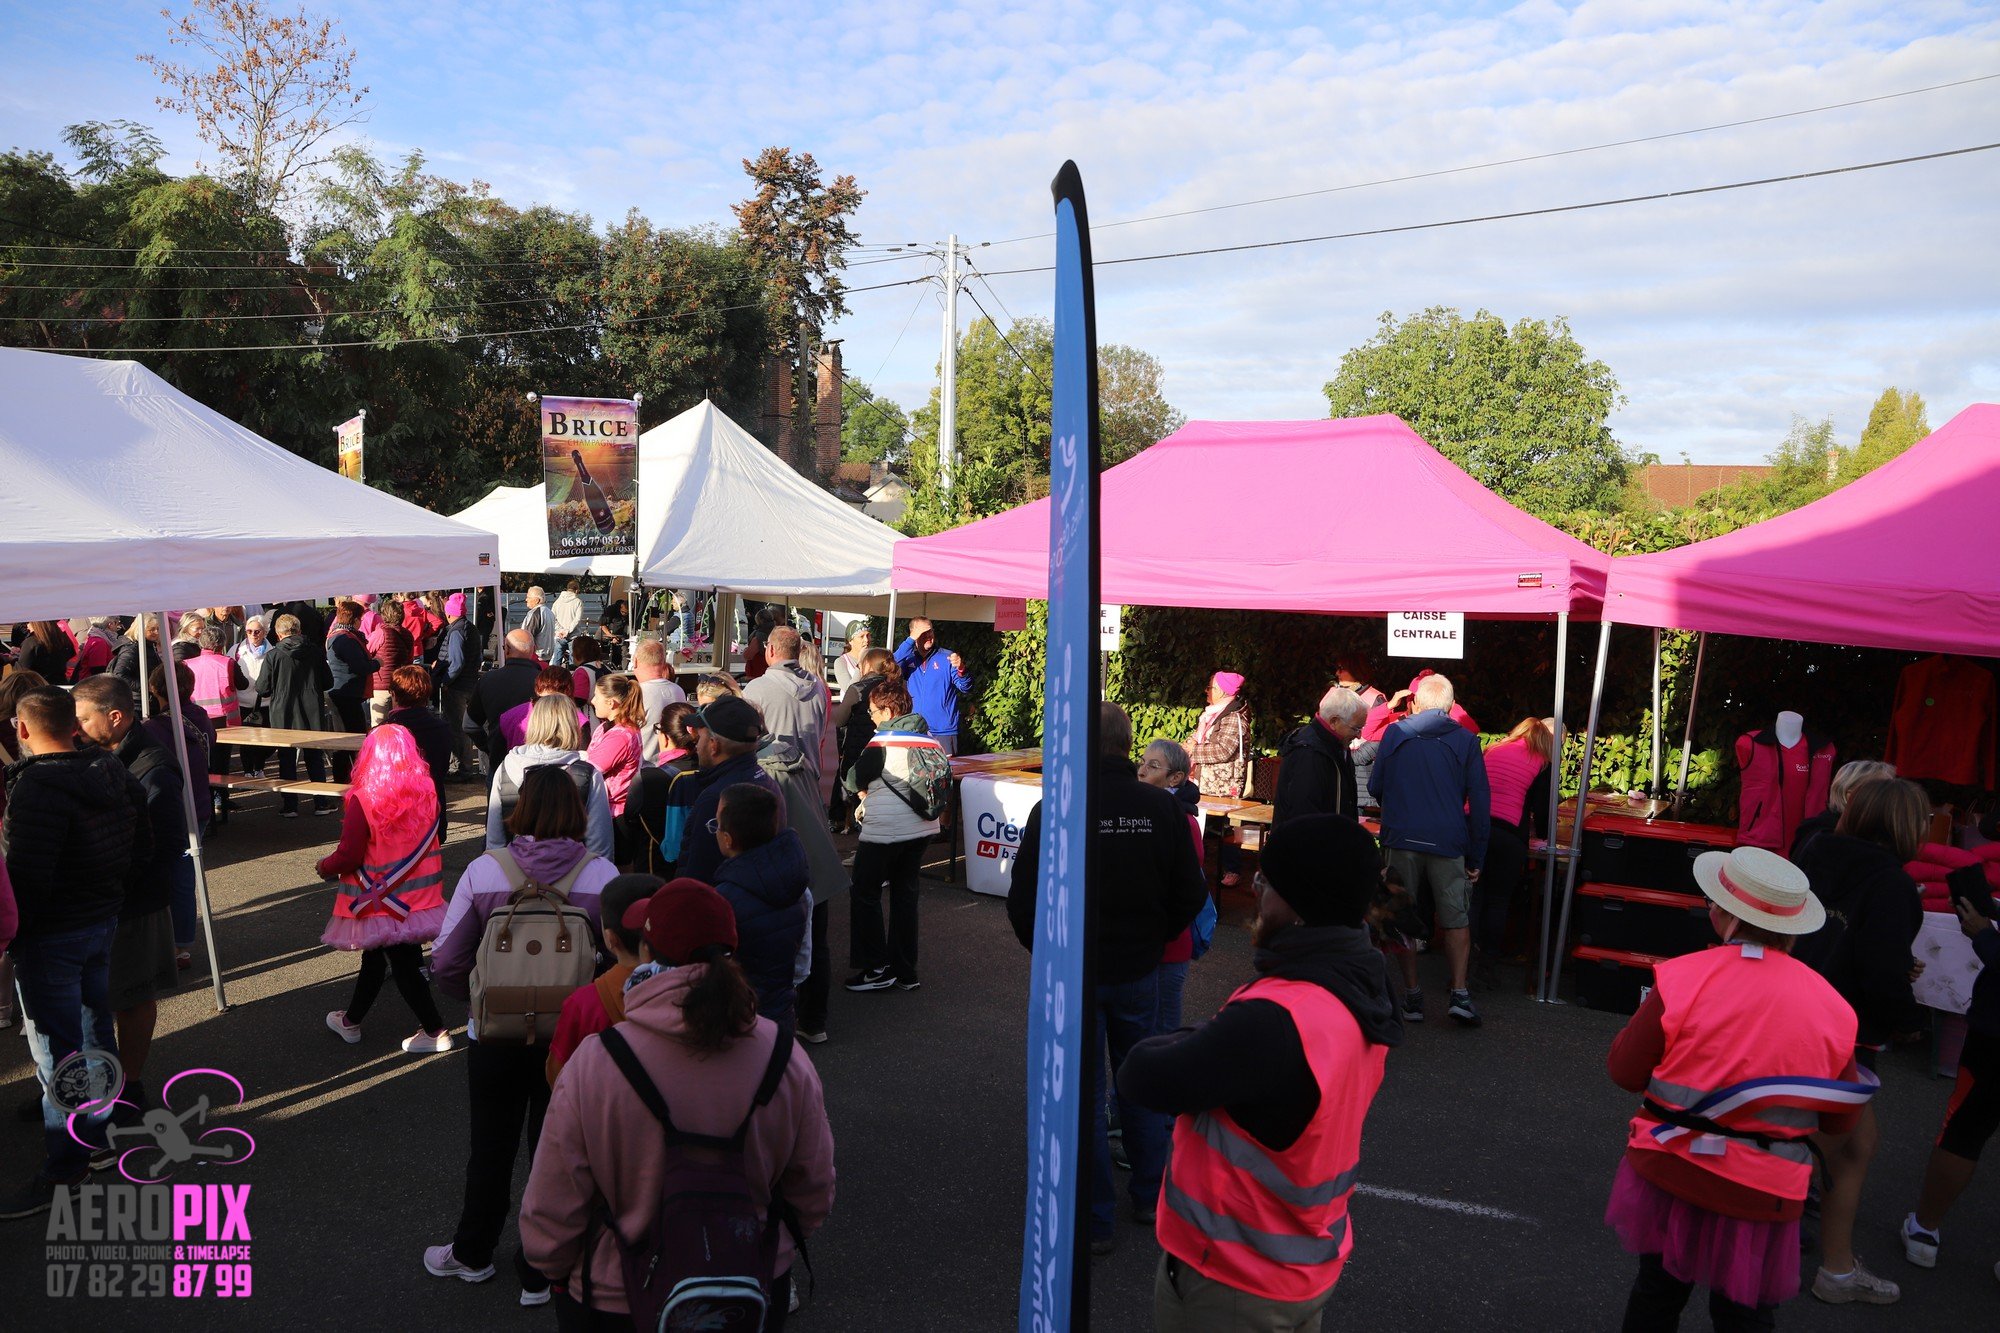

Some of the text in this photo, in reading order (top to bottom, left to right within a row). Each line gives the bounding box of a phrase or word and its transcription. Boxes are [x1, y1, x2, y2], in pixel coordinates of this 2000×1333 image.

[567, 439, 617, 447] CHAMPAGNE
[561, 535, 626, 547] 06 86 77 08 24
[1403, 612, 1446, 620] CAISSE
[1393, 629, 1457, 639] CENTRALE
[980, 844, 996, 856] LA
